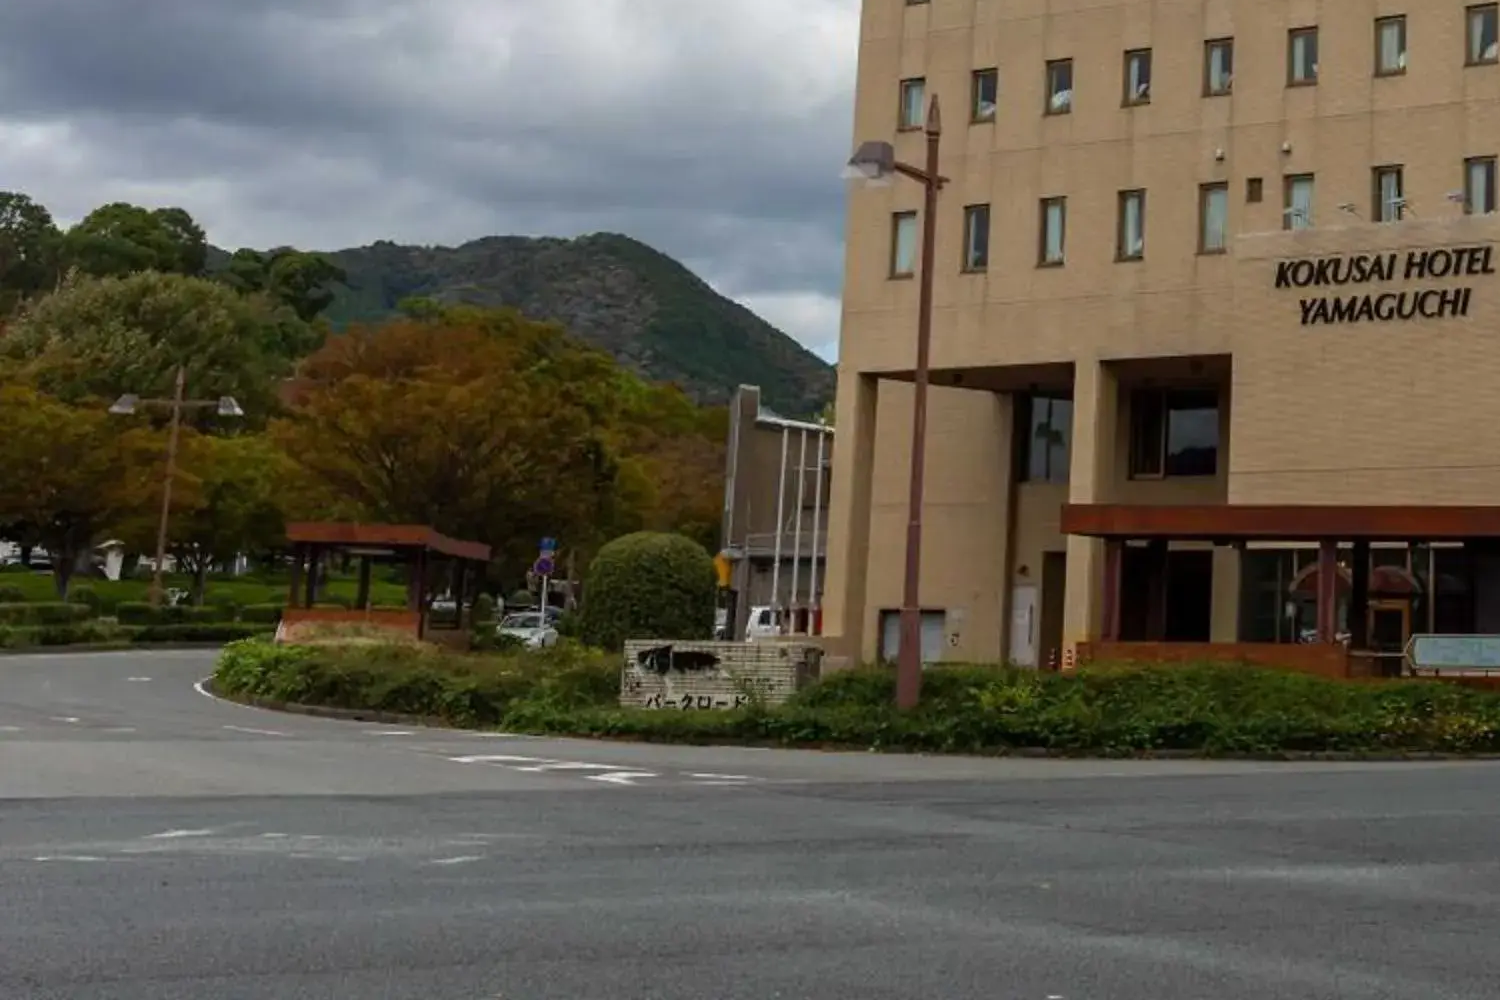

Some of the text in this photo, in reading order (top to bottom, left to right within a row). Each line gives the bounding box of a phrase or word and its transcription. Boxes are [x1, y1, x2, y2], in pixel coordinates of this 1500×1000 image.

[1274, 246, 1496, 289] KOKUSAI HOTEL
[1299, 287, 1472, 325] YAMAGUCHI
